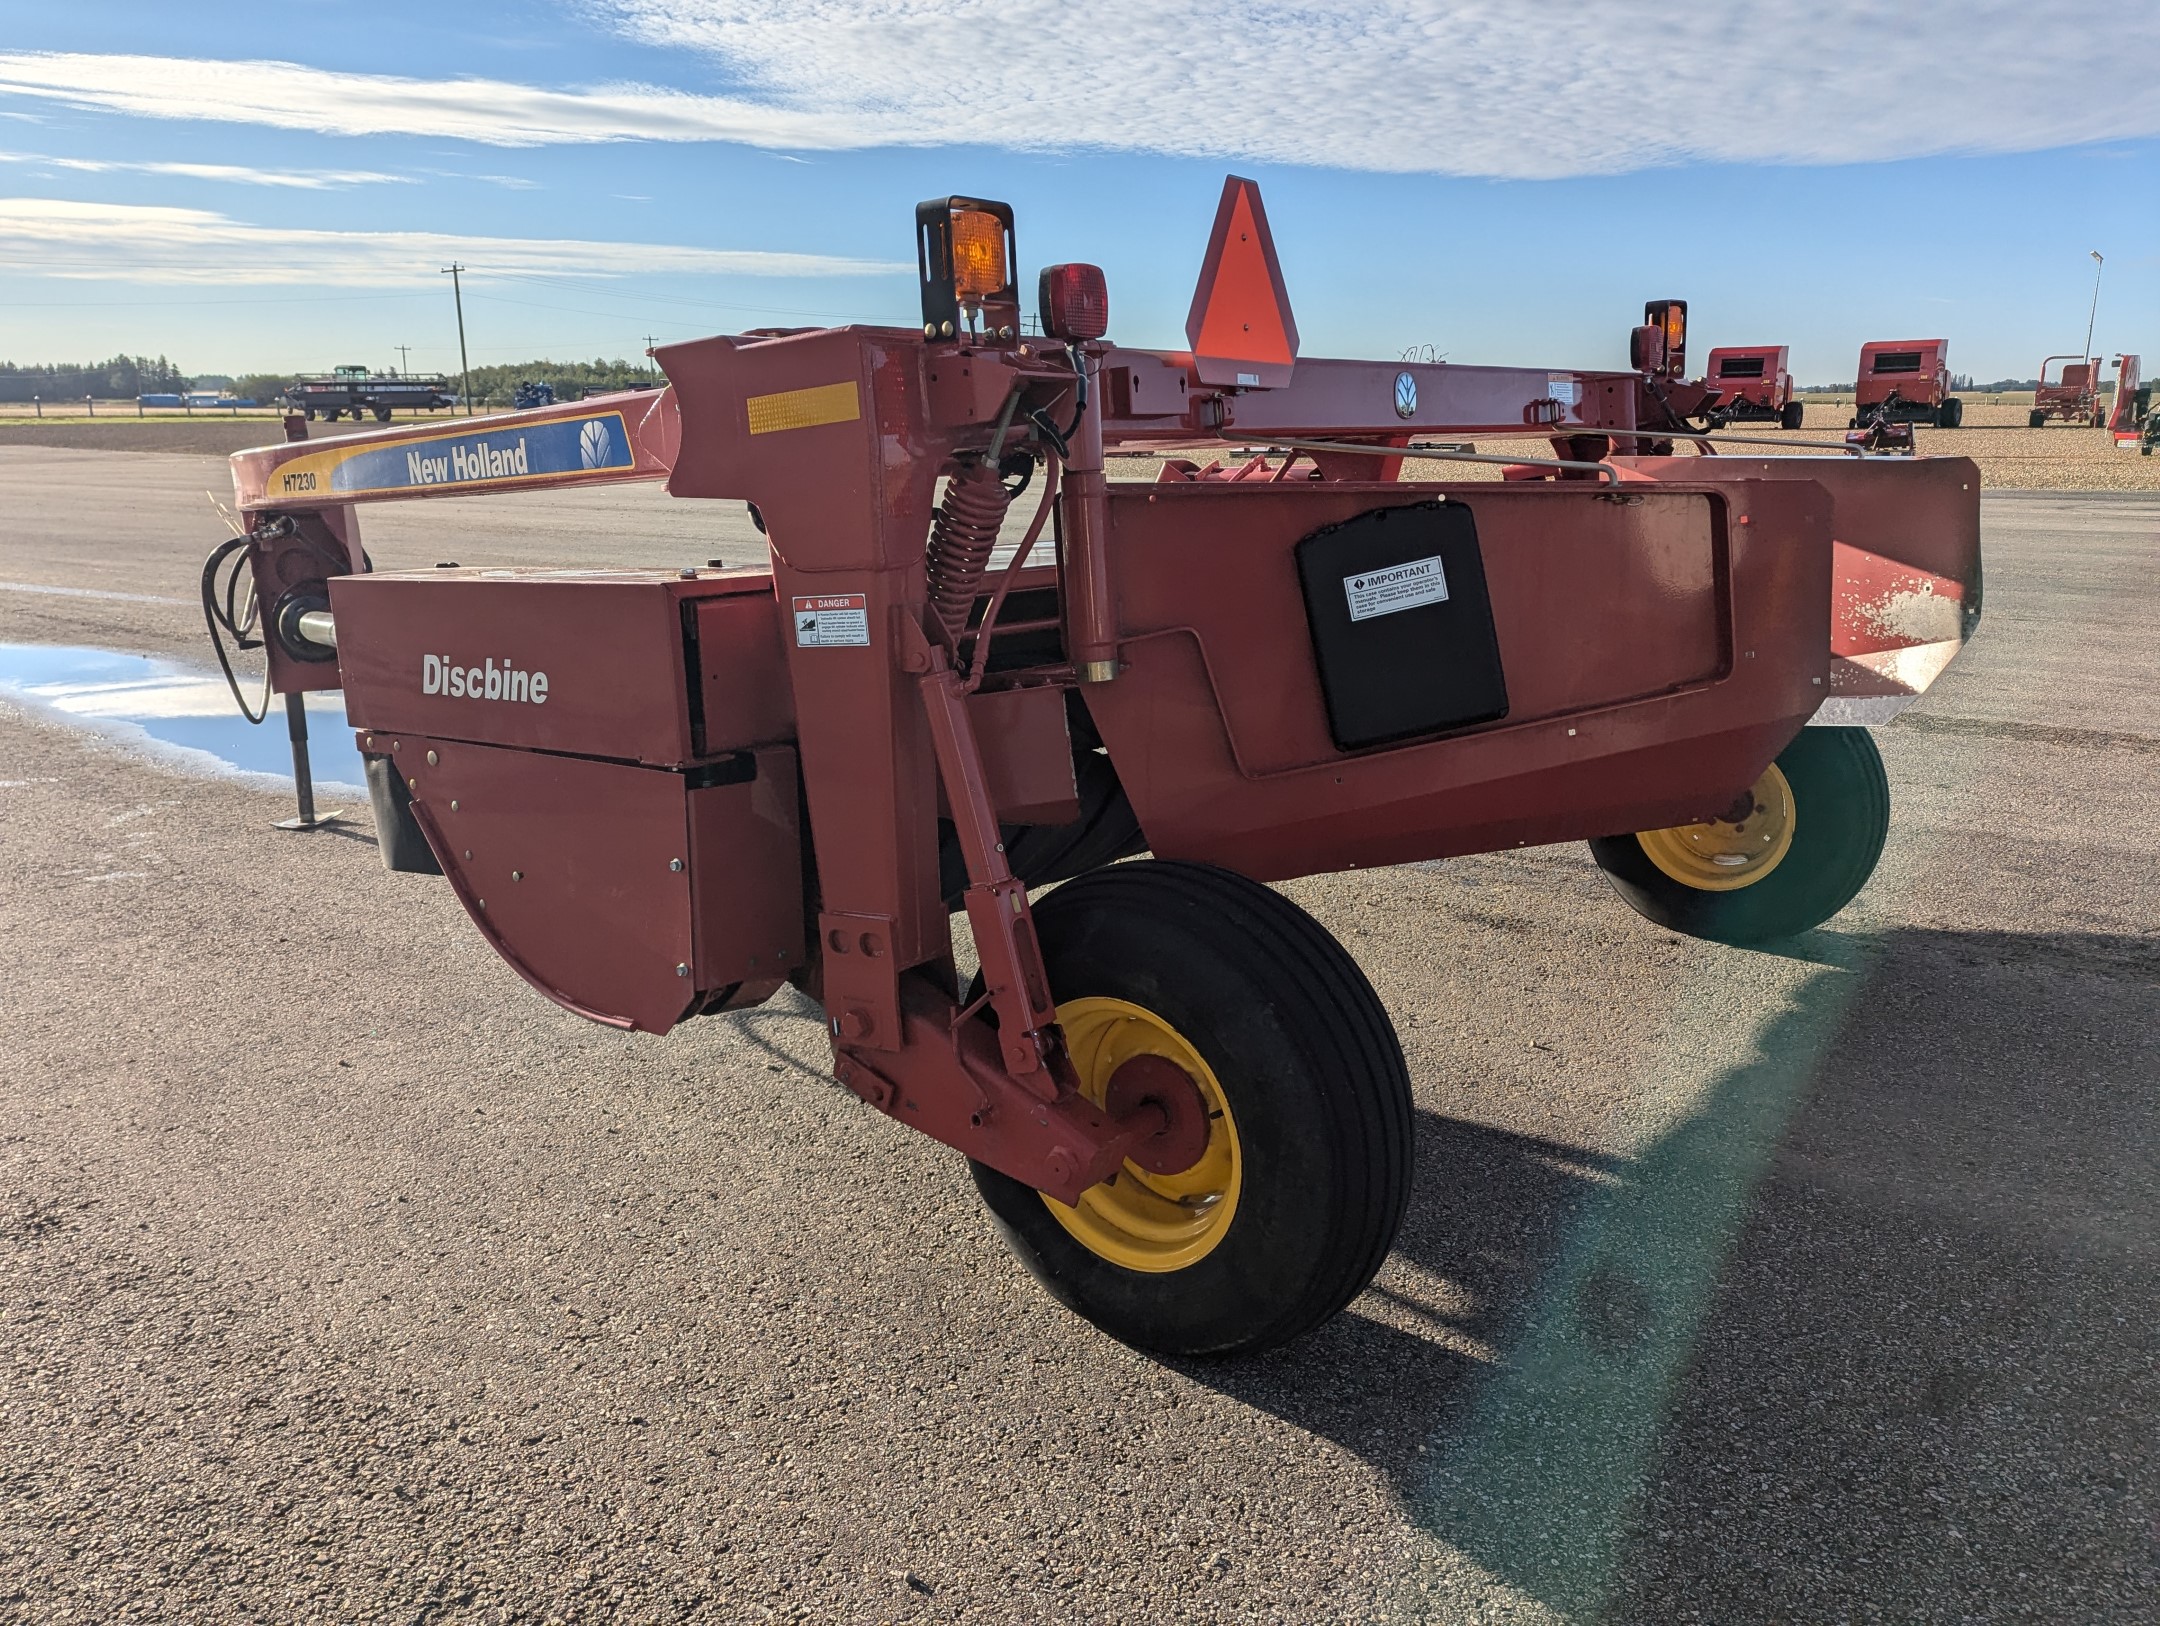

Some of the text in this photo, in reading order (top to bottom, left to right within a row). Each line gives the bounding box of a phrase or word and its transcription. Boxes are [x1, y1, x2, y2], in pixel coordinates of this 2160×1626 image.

[407, 438, 529, 485] New Holland
[283, 473, 317, 492] H7230
[1368, 564, 1431, 587] IMPORTANT
[818, 599, 850, 608] DANGER
[423, 654, 548, 704] Discbine
